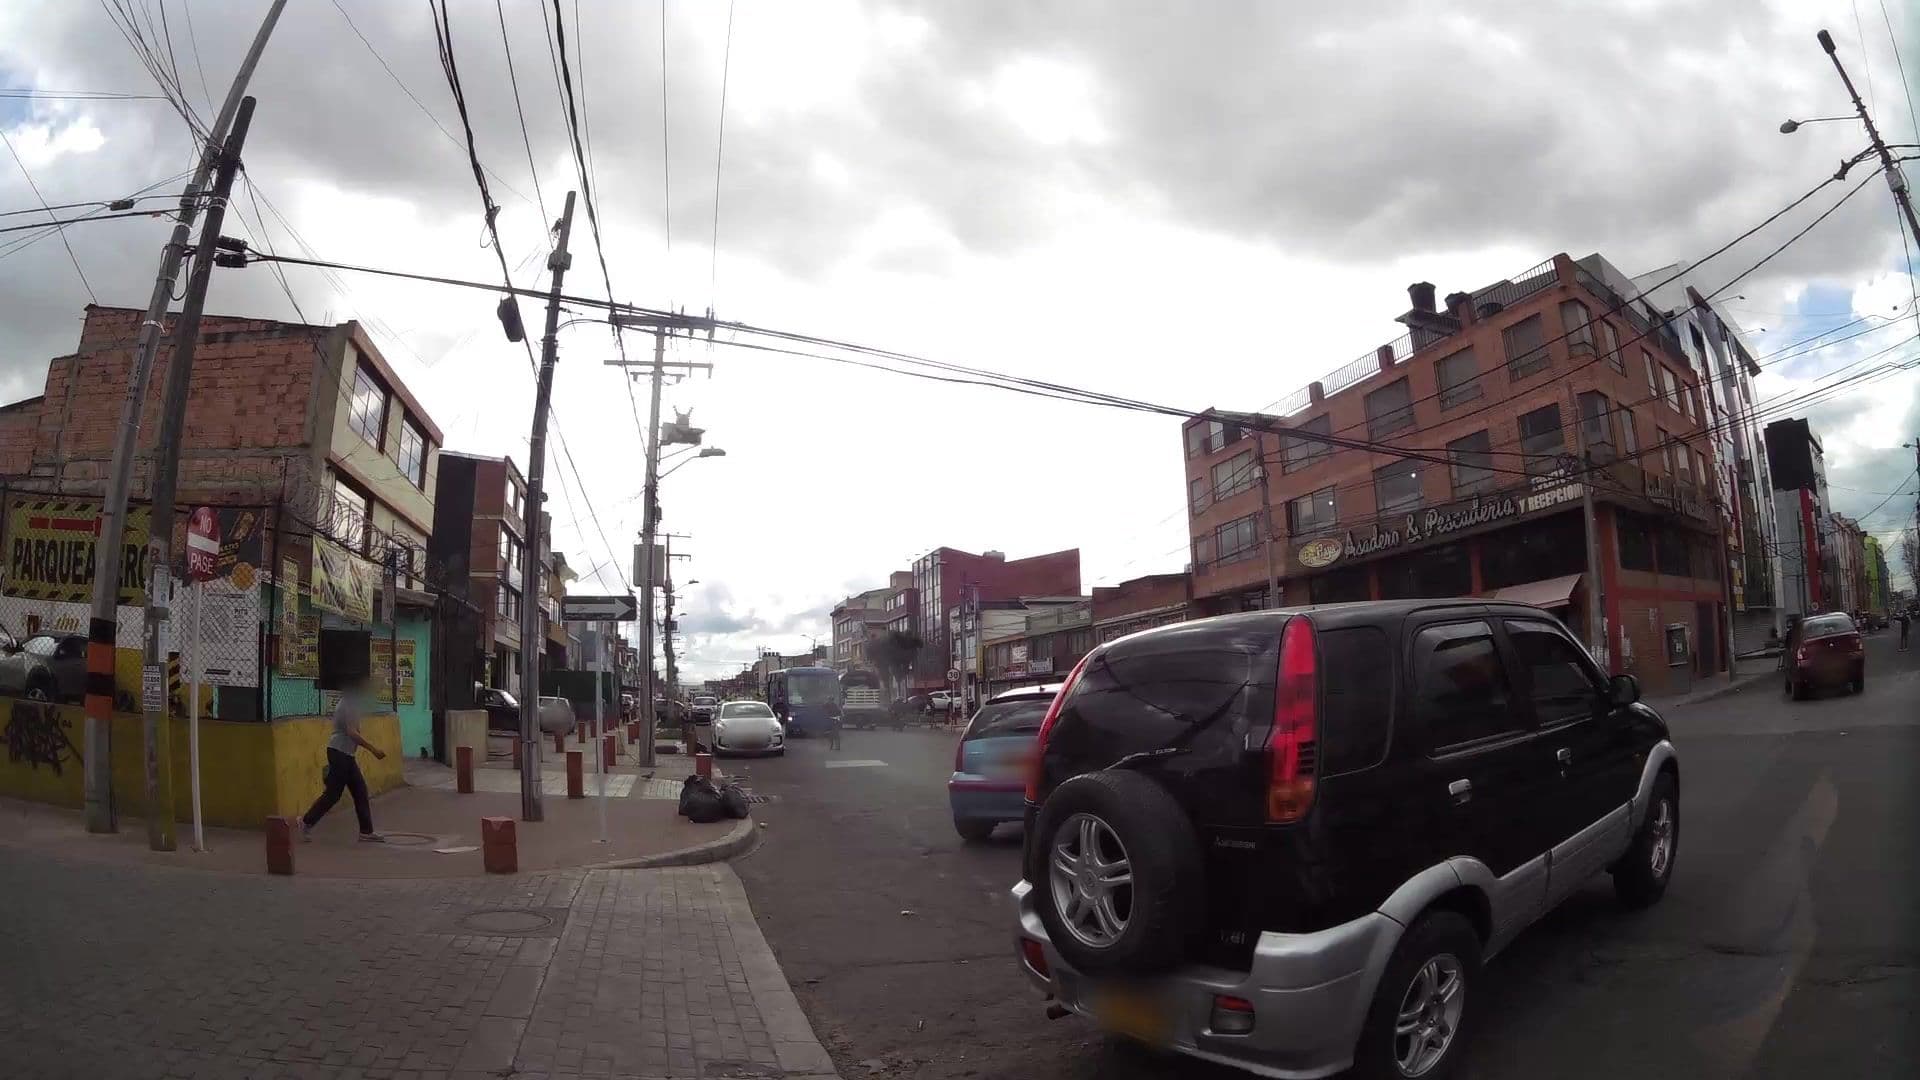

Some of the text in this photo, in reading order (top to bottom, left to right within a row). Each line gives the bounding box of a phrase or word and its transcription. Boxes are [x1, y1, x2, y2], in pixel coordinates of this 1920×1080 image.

[200, 514, 213, 533] NO
[1344, 523, 1400, 559] Asadero
[1406, 513, 1422, 543] &
[1519, 499, 1527, 514] Y
[1528, 482, 1593, 512] RECEPCION
[190, 553, 214, 575] PASE
